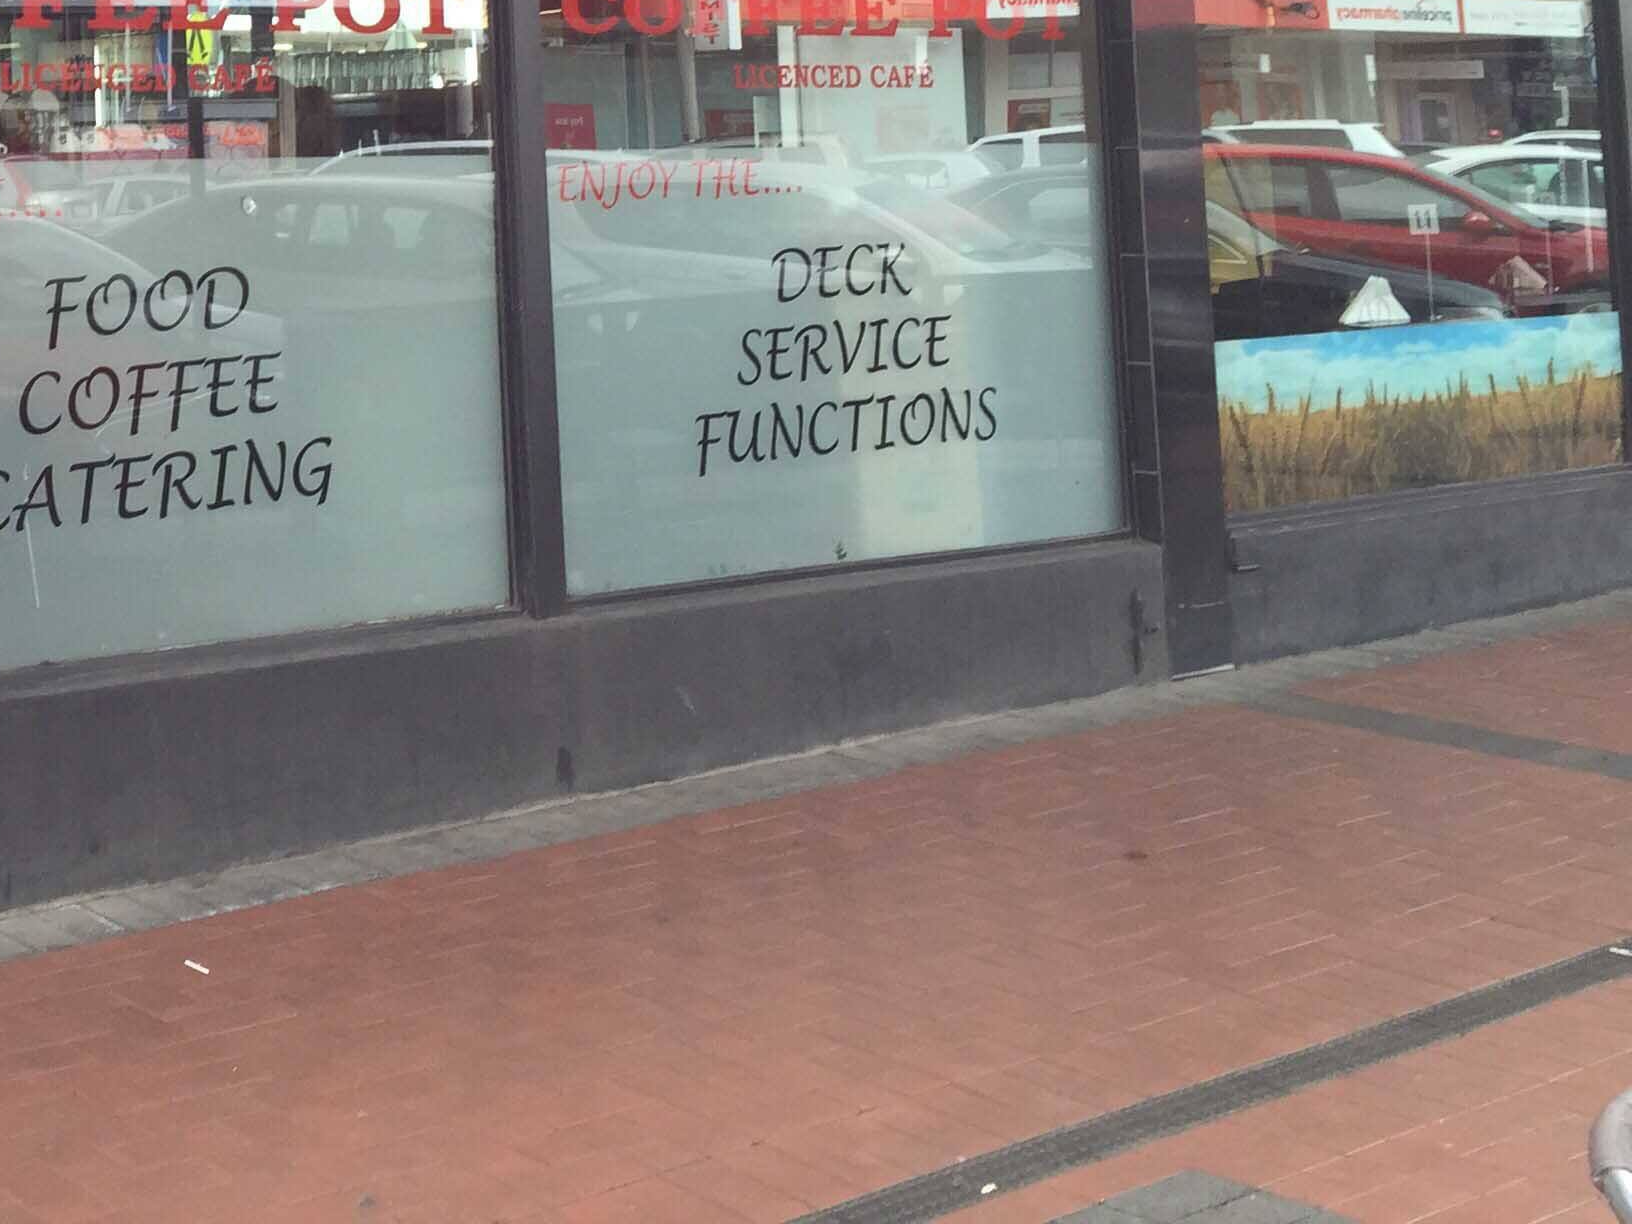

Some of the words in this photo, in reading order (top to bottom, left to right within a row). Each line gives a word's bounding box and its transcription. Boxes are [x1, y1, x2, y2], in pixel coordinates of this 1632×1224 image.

[0, 62, 177, 93] LICENCED
[189, 57, 278, 93] CAFÉ
[734, 63, 863, 90] LICENCED
[869, 58, 934, 89] CAFÉ
[558, 158, 675, 209] ENJOY
[771, 241, 912, 303] DECK
[45, 266, 249, 350] FOOD
[738, 314, 952, 386] SERVICE
[19, 351, 282, 436] COFFEE
[695, 386, 998, 478] FUNCTIONS
